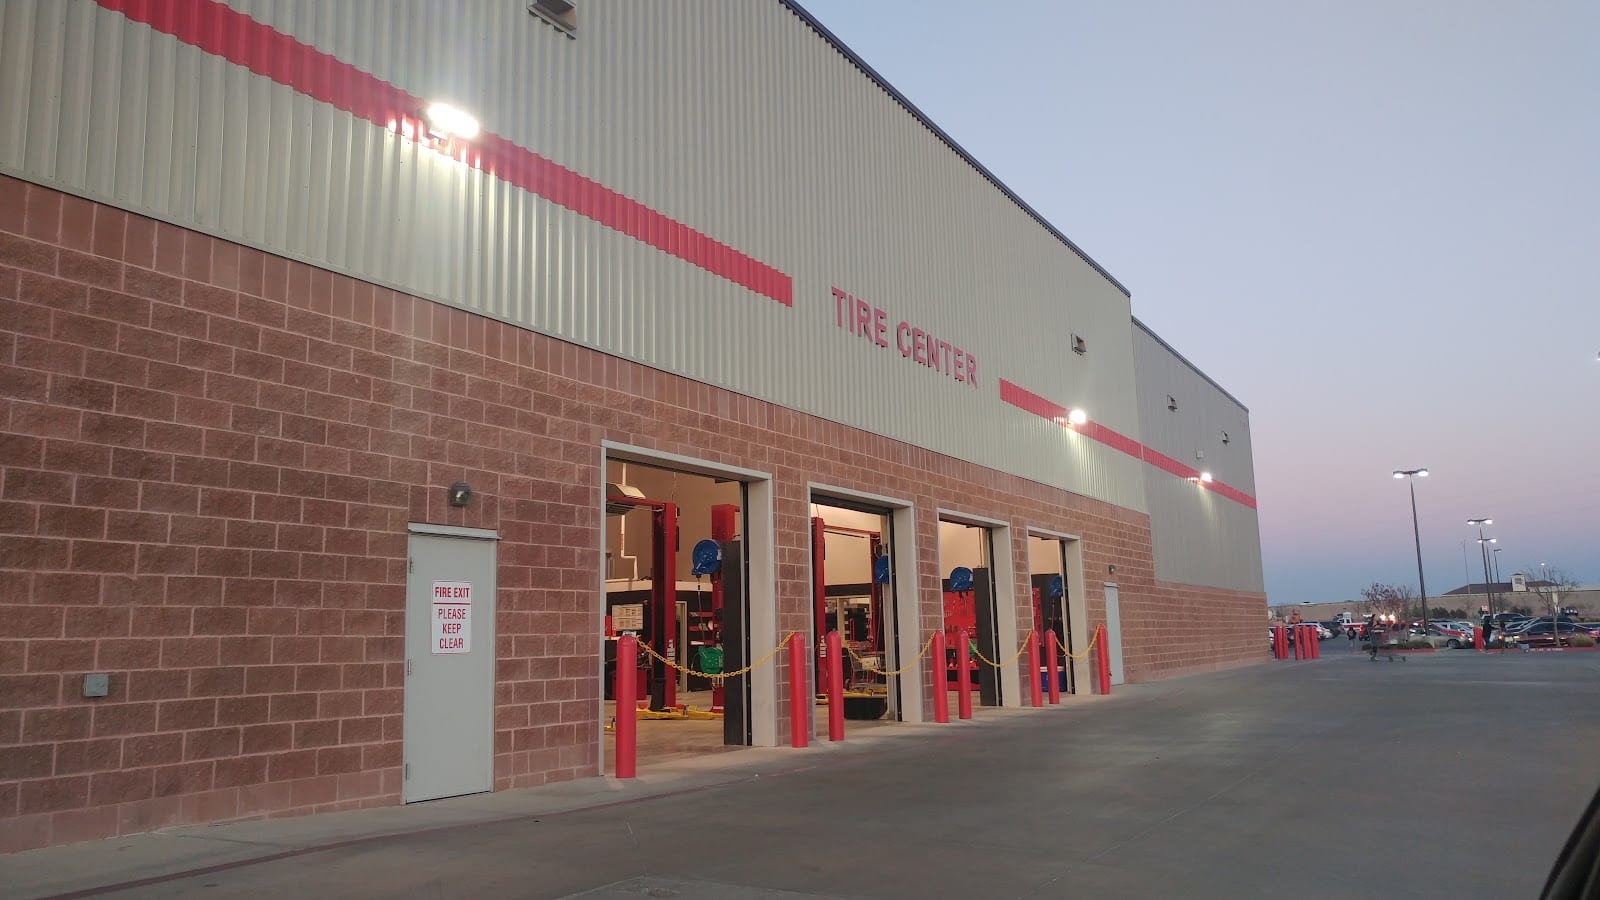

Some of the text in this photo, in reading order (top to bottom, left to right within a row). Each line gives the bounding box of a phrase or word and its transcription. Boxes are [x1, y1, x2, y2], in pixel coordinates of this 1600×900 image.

[831, 285, 978, 389] TIRE CENTER
[435, 587, 469, 598] FIRE EXIT
[438, 608, 466, 619] PLEASE
[443, 623, 461, 633] KEEP
[440, 638, 463, 649] CLEAR
